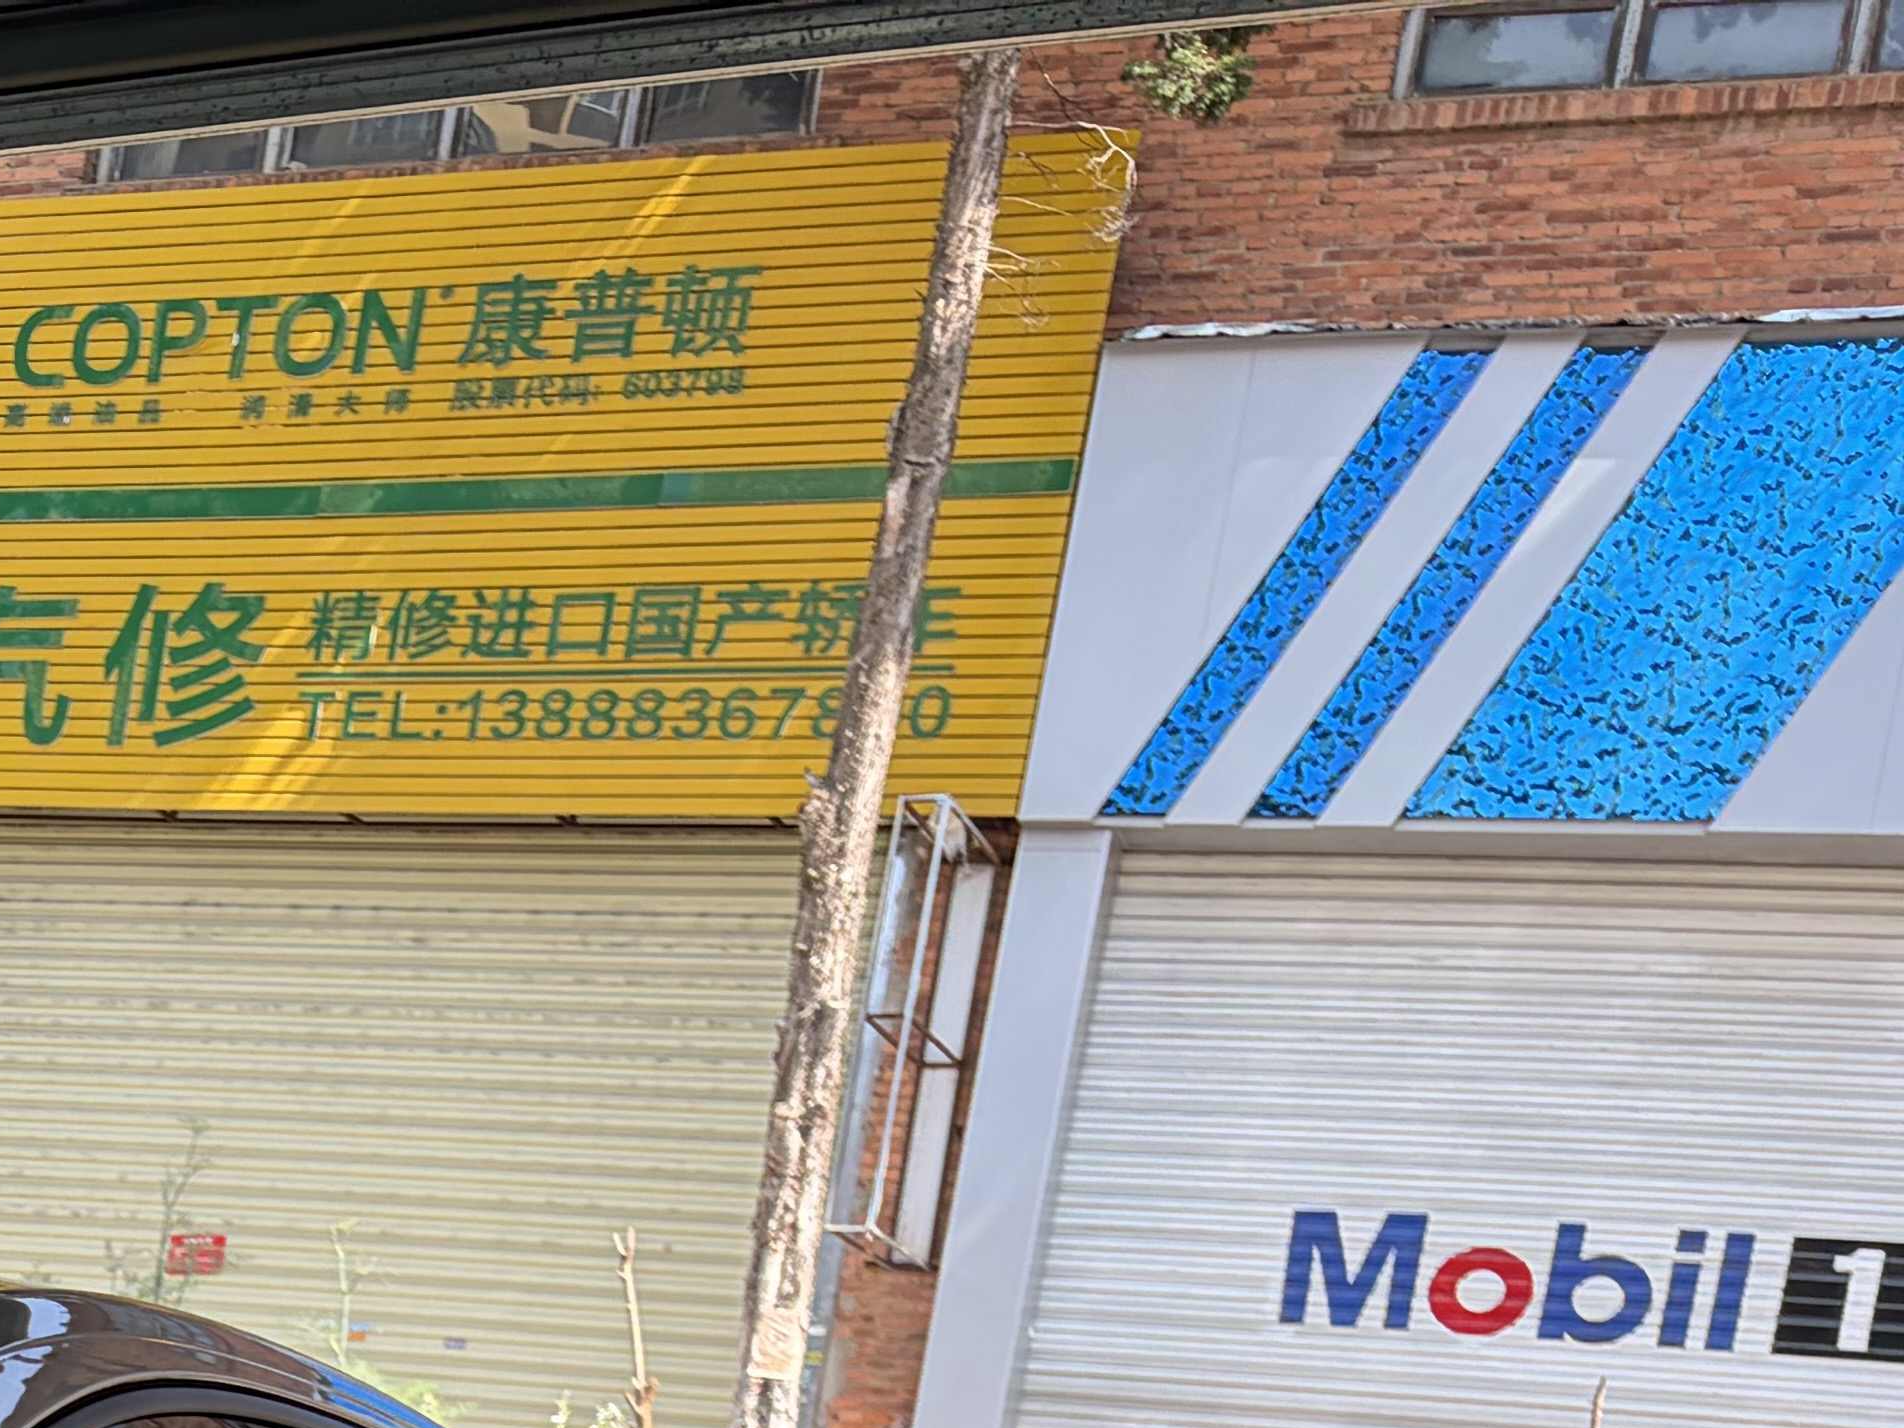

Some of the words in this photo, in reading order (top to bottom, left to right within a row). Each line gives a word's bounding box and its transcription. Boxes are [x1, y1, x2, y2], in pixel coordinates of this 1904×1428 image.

[13, 287, 425, 387] COPTON
[458, 264, 762, 368] 康普顿
[1279, 1211, 1756, 1352] Mobil
[1833, 1247, 1886, 1353] 1
